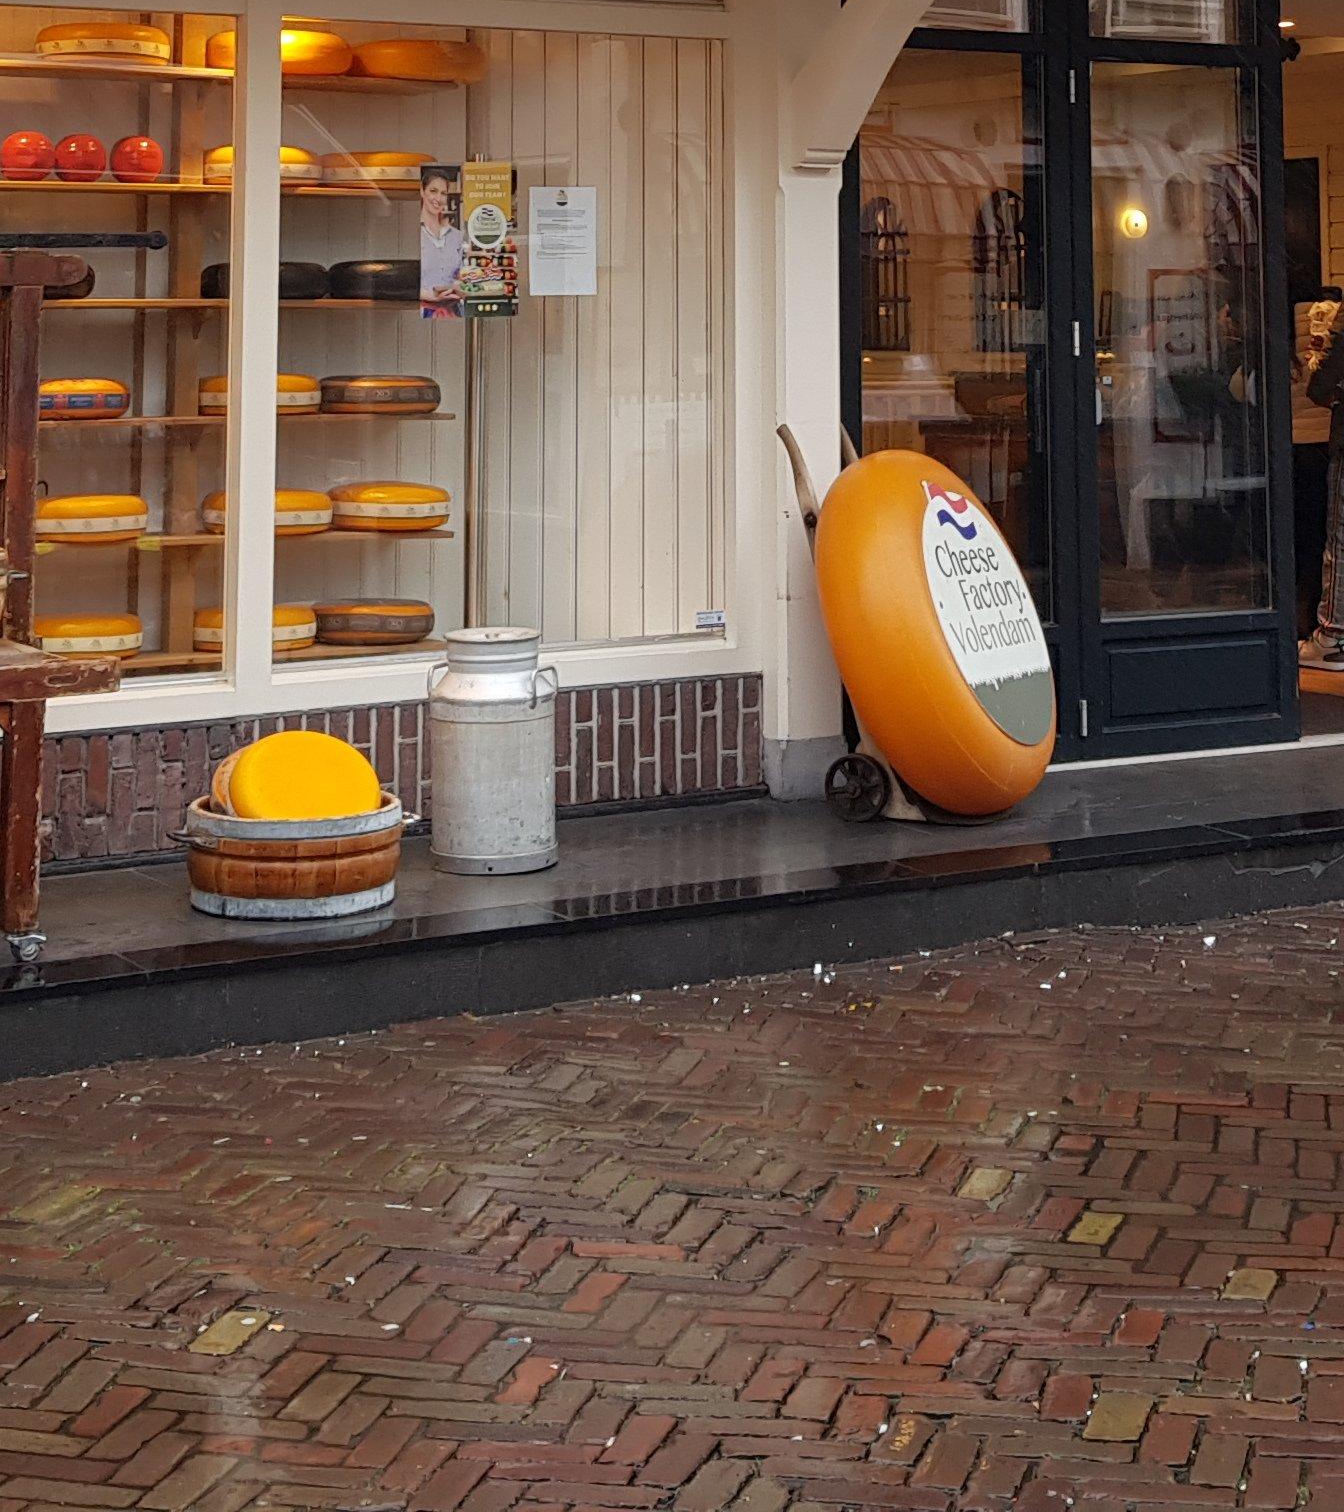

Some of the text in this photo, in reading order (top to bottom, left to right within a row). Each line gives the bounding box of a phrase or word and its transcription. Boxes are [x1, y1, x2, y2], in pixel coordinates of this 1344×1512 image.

[935, 540, 998, 578] Cheese
[959, 577, 1023, 615] Factory
[951, 610, 1036, 655] Volendam
